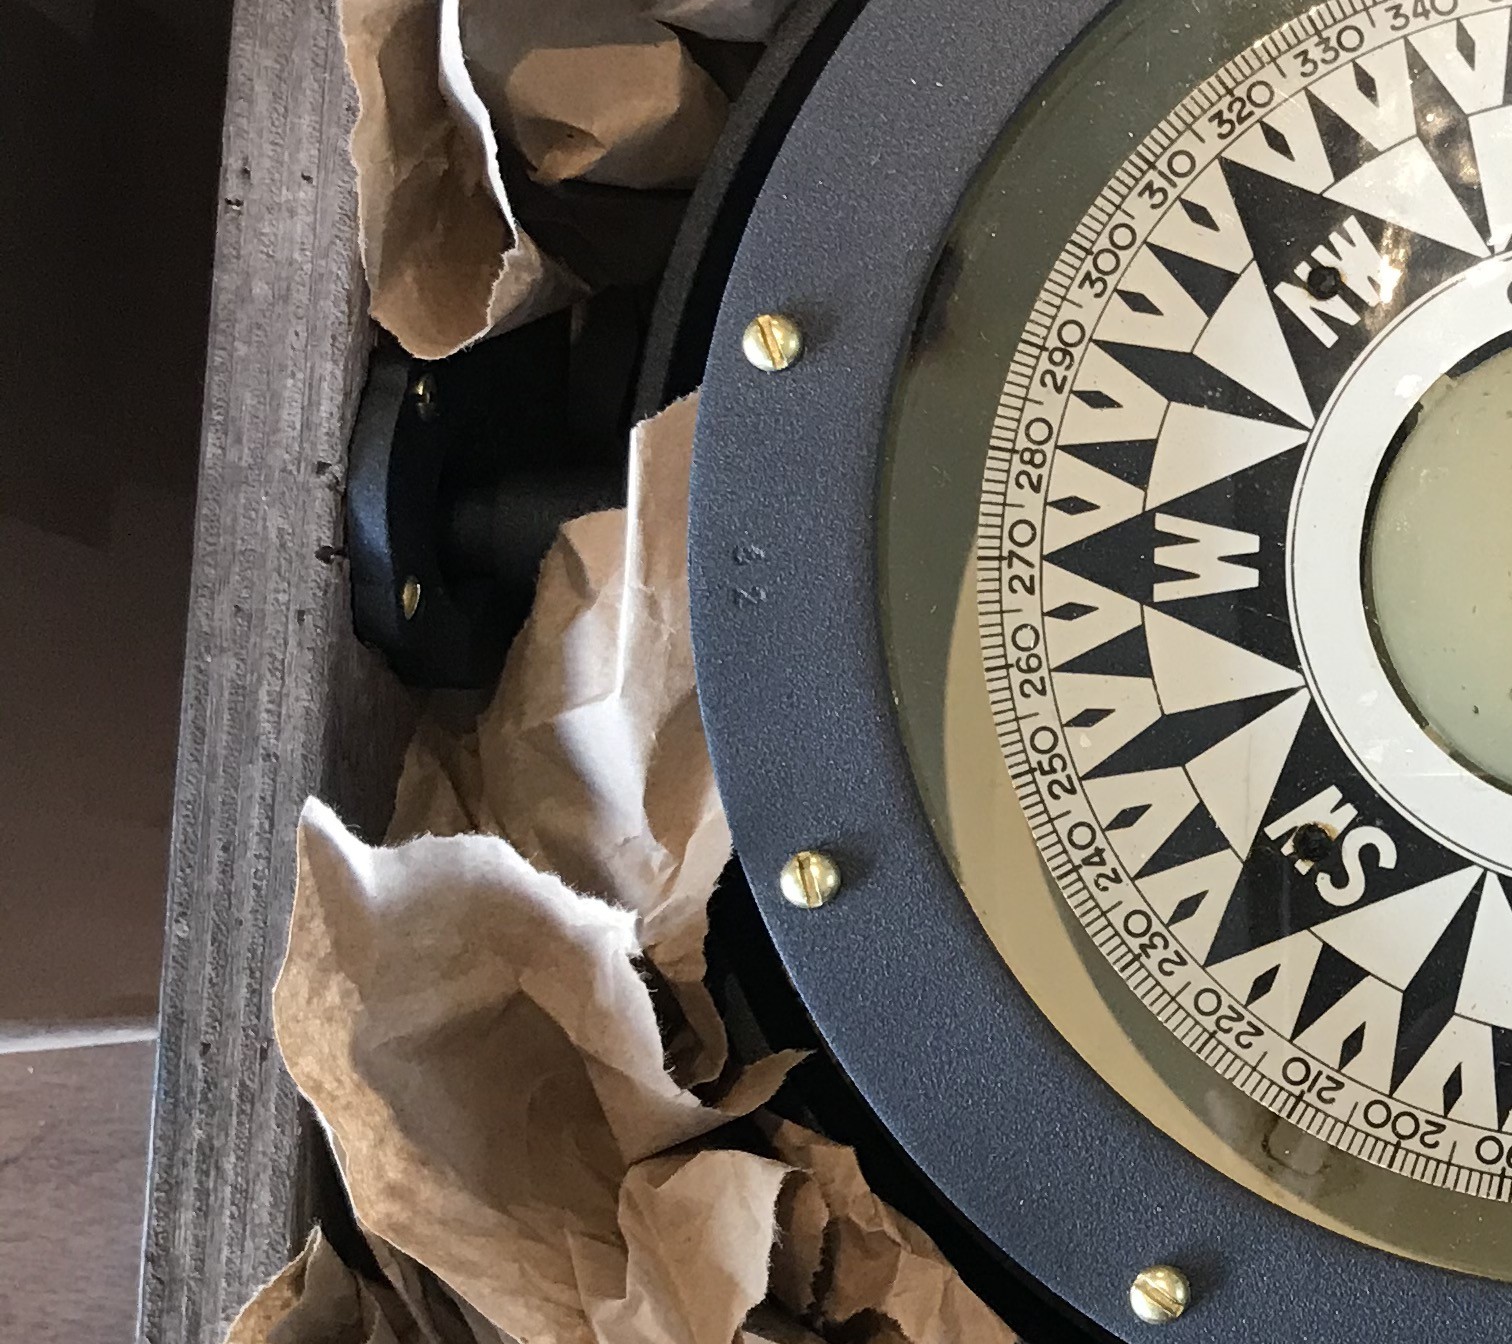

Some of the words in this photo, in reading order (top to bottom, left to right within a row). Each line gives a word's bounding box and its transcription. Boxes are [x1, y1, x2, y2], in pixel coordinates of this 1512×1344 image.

[1292, 24, 1365, 78] 330
[1208, 79, 1275, 141] 320
[1137, 149, 1197, 211] 310
[1079, 221, 1138, 300] 300
[1273, 214, 1402, 349] NW
[1039, 318, 1087, 395] 290
[1015, 416, 1054, 495] 280
[1007, 518, 1037, 596] 270
[1154, 513, 1260, 603] W
[1011, 623, 1048, 698] 260
[1029, 725, 1078, 801] 250
[1067, 820, 1123, 893] 240
[1123, 909, 1188, 977] 230
[1193, 986, 1265, 1052] 220
[1281, 1055, 1346, 1106] 210
[1363, 1098, 1447, 1150] 200
